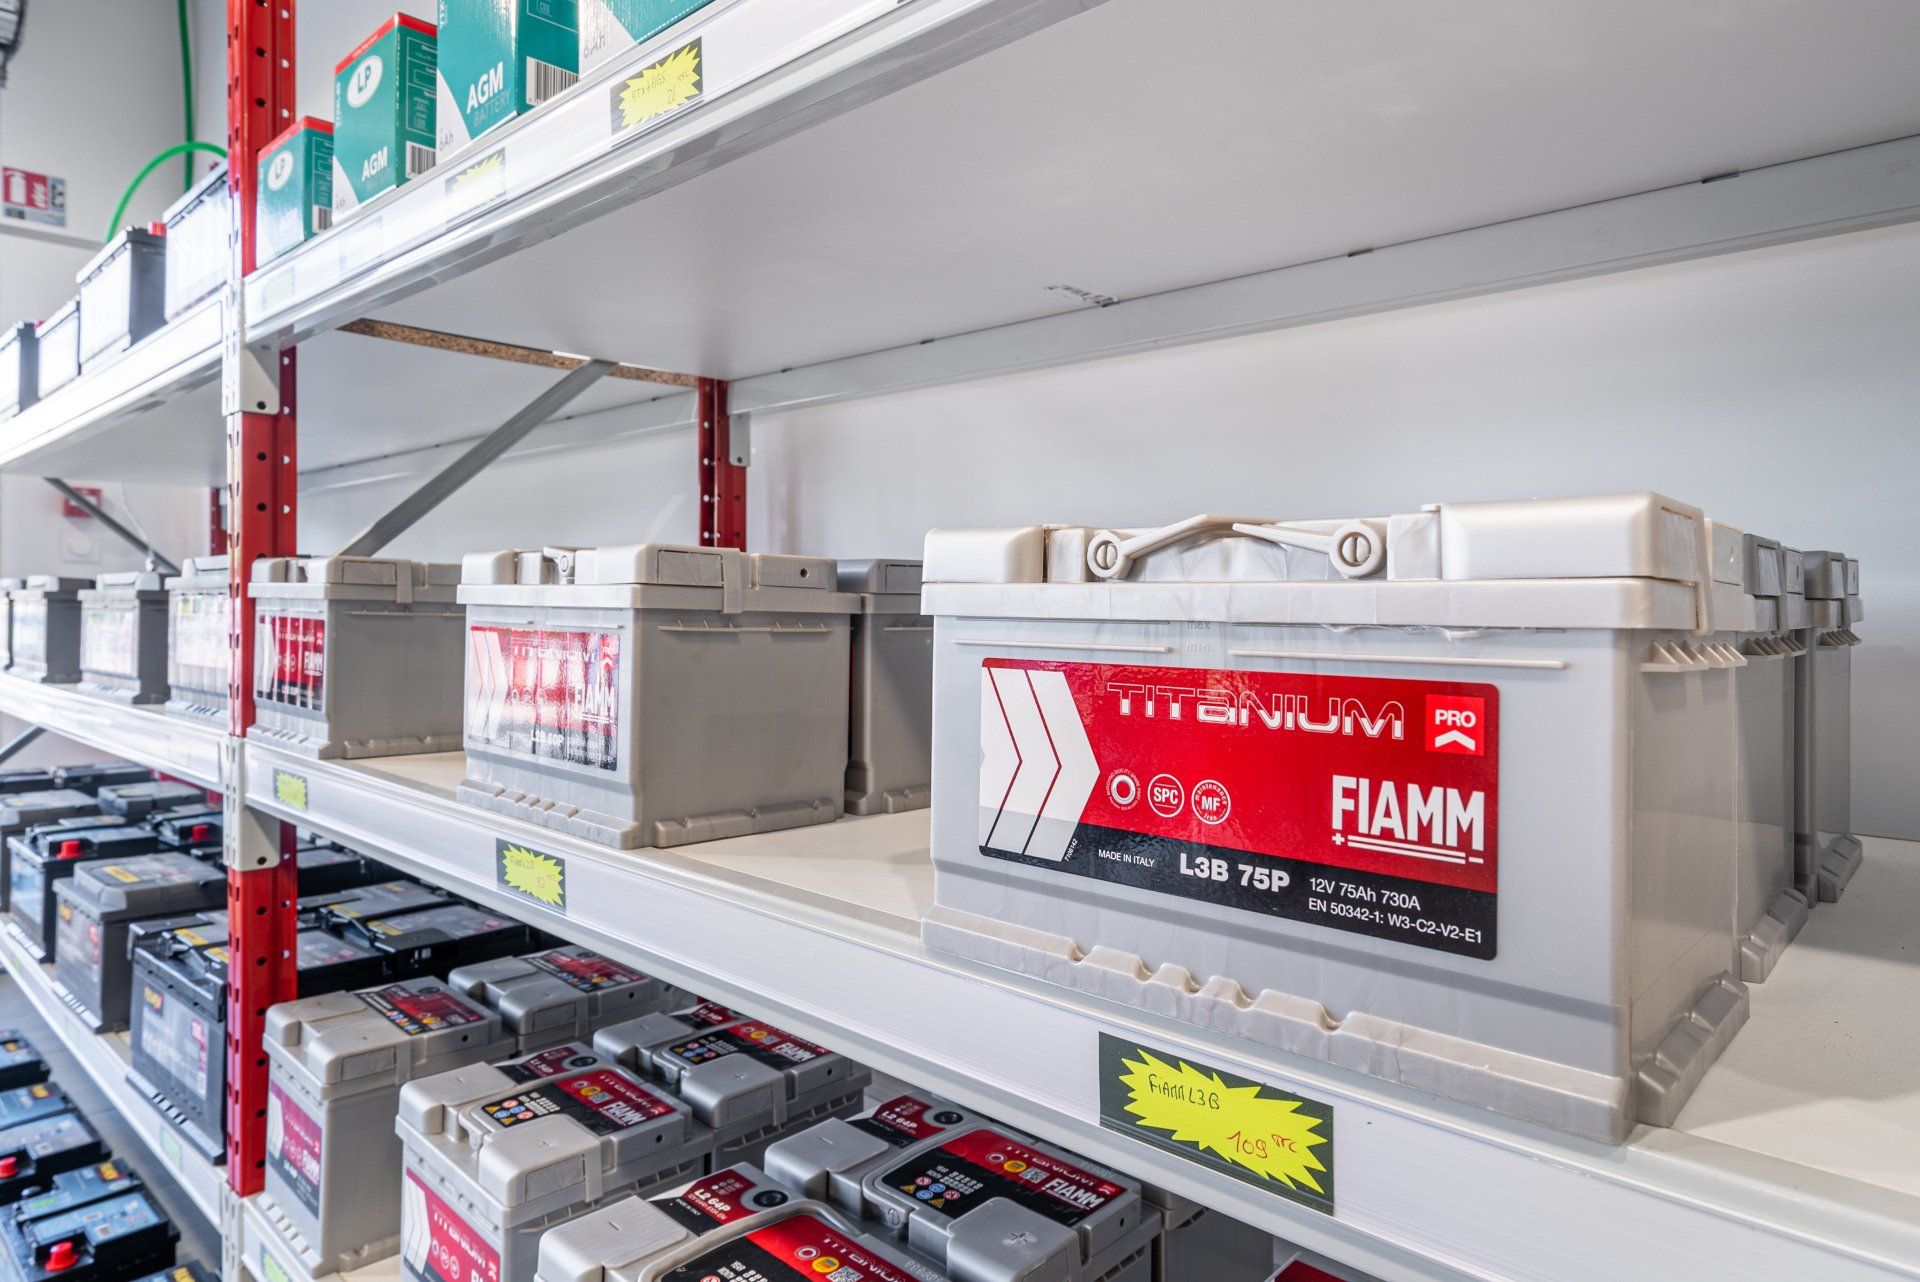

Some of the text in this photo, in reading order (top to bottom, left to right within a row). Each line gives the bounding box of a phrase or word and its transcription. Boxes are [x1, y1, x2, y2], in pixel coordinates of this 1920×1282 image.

[357, 64, 372, 94] LP
[466, 61, 504, 114] AGM
[474, 86, 512, 128] BATTERY
[361, 146, 389, 182] AGM
[1435, 709, 1476, 728] PRO
[1153, 787, 1179, 805] SPC
[1201, 796, 1221, 811] MF
[1203, 813, 1218, 821] free
[1332, 775, 1485, 851] FIAMM
[1098, 849, 1155, 867] MADE IN ITALY
[1179, 853, 1290, 892] L3B 75P
[1309, 877, 1421, 911] 12V 75Ah 730A
[1308, 898, 1482, 943] EN 50342-1: W3-C2-V2-E1
[603, 1100, 647, 1126] FIAMM
[1188, 1089, 1221, 1110] L3B
[1226, 1130, 1268, 1159] 109
[693, 1188, 711, 1201] L2
[708, 1197, 731, 1213] 64P
[1044, 1177, 1106, 1209] FIAMM
